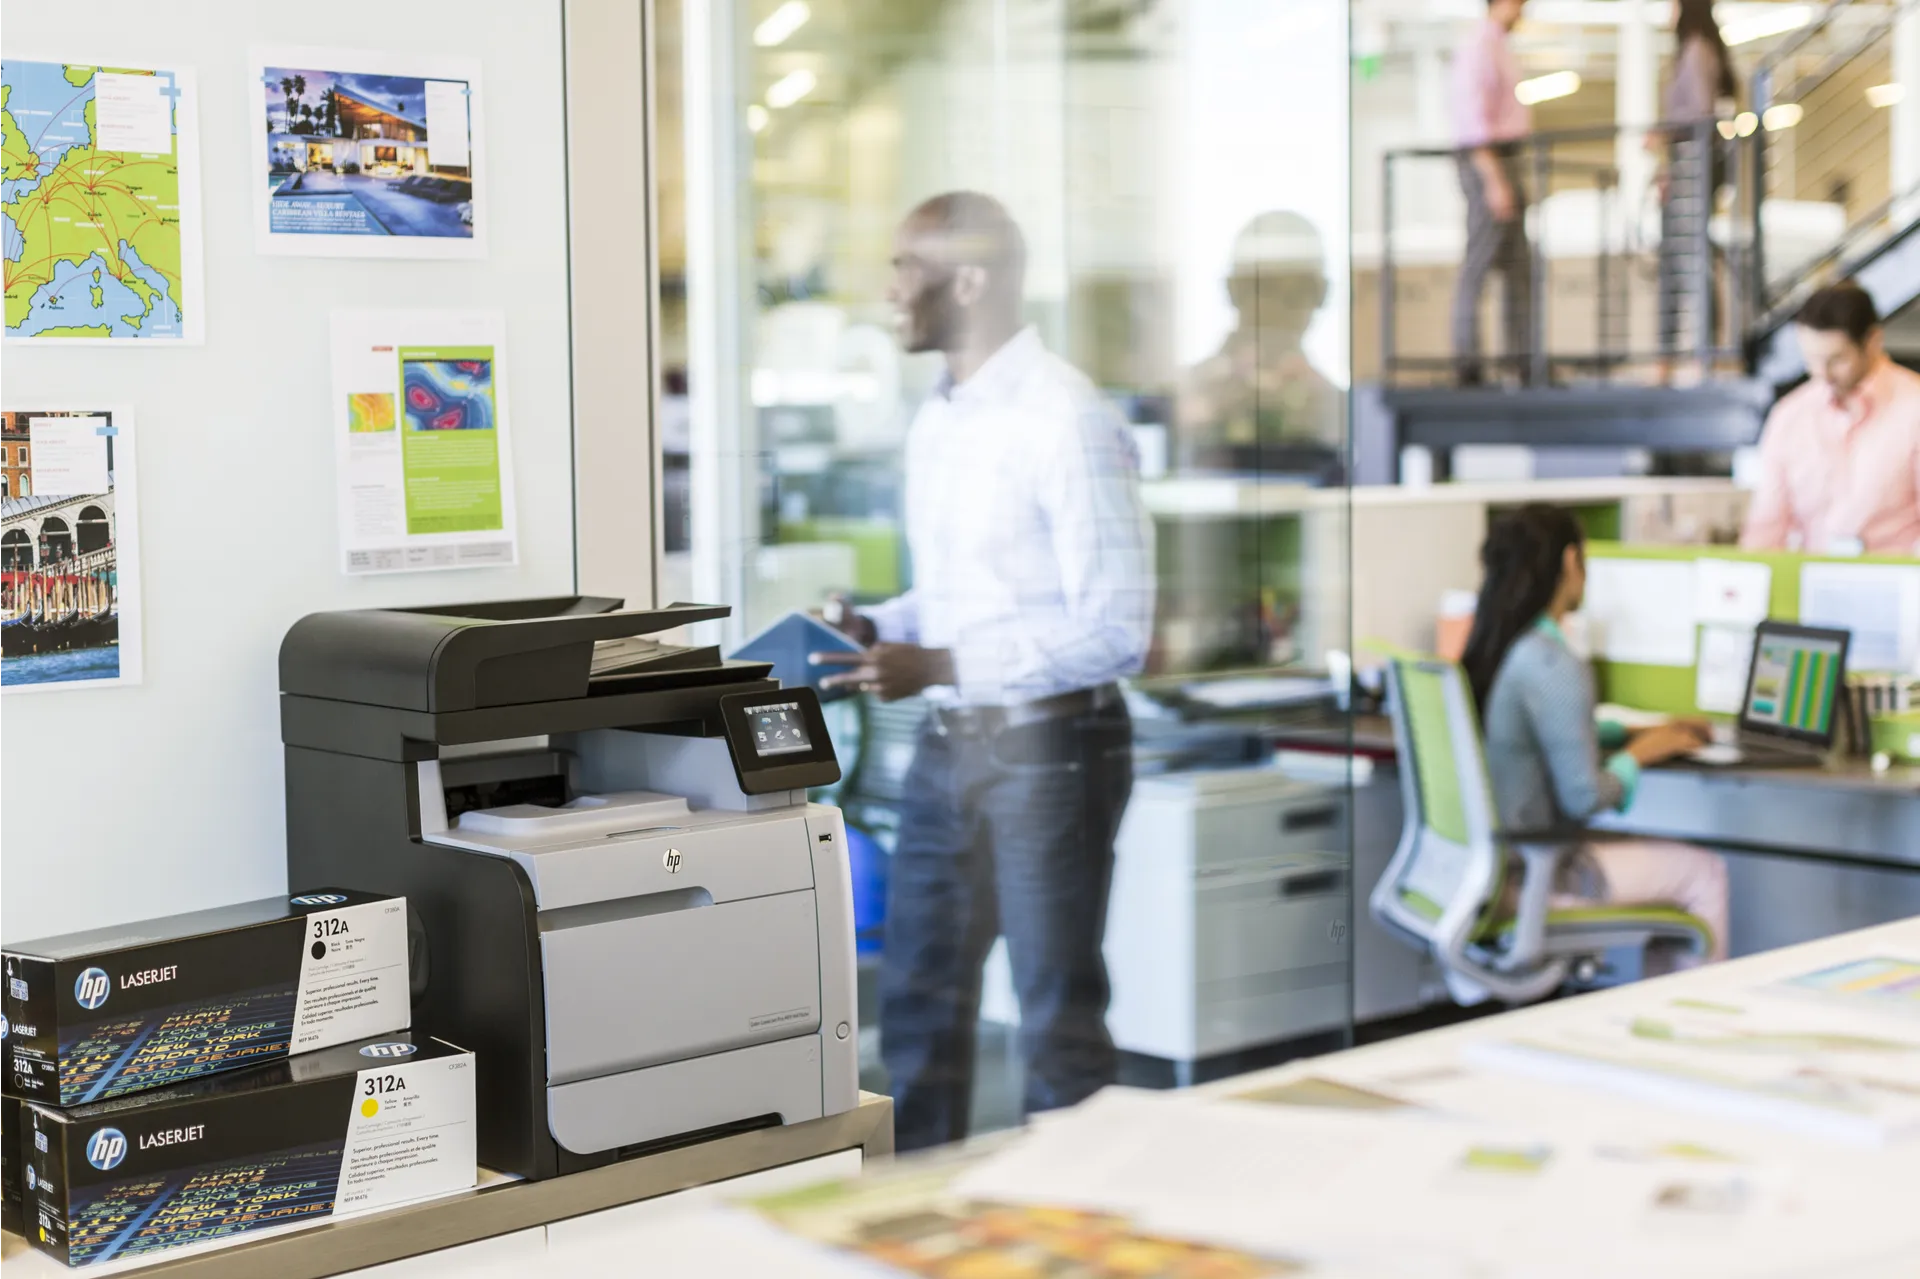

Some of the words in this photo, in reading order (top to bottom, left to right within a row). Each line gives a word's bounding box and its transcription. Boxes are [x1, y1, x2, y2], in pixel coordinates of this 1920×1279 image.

[666, 849, 681, 873] hp
[296, 894, 341, 905] hp
[313, 918, 349, 938] 312A
[120, 965, 178, 989] LASERJET
[78, 967, 108, 1010] hp
[160, 1015, 231, 1030] PARIS
[166, 1009, 232, 1023] MIAMI
[12, 1023, 37, 1037] LASERJET
[146, 1031, 209, 1046] HONG
[223, 1021, 276, 1035] KONG
[156, 1022, 227, 1037] TOKYO
[138, 1041, 189, 1056] NEW
[205, 1031, 261, 1045] YORK
[368, 1043, 410, 1057] hp
[131, 1044, 230, 1065] MADRID
[13, 1058, 34, 1075] 312A
[113, 1061, 222, 1087] SYDNEY
[122, 1060, 177, 1076] RIO
[364, 1074, 406, 1096] 312A
[139, 1124, 205, 1150] LASERJET
[373, 1140, 400, 1151] professional
[90, 1128, 124, 1170] hp
[183, 1175, 265, 1190] PARIS
[190, 1168, 268, 1183] MIAMI
[167, 1192, 240, 1207] HONG
[256, 1181, 318, 1195] KONG
[179, 1182, 261, 1197] TOKYO
[158, 1202, 217, 1217] NEW
[236, 1191, 300, 1205] YORK
[149, 1203, 263, 1226] MADRID
[128, 1222, 255, 1248] SYDNEY
[139, 1221, 203, 1237] RIO
